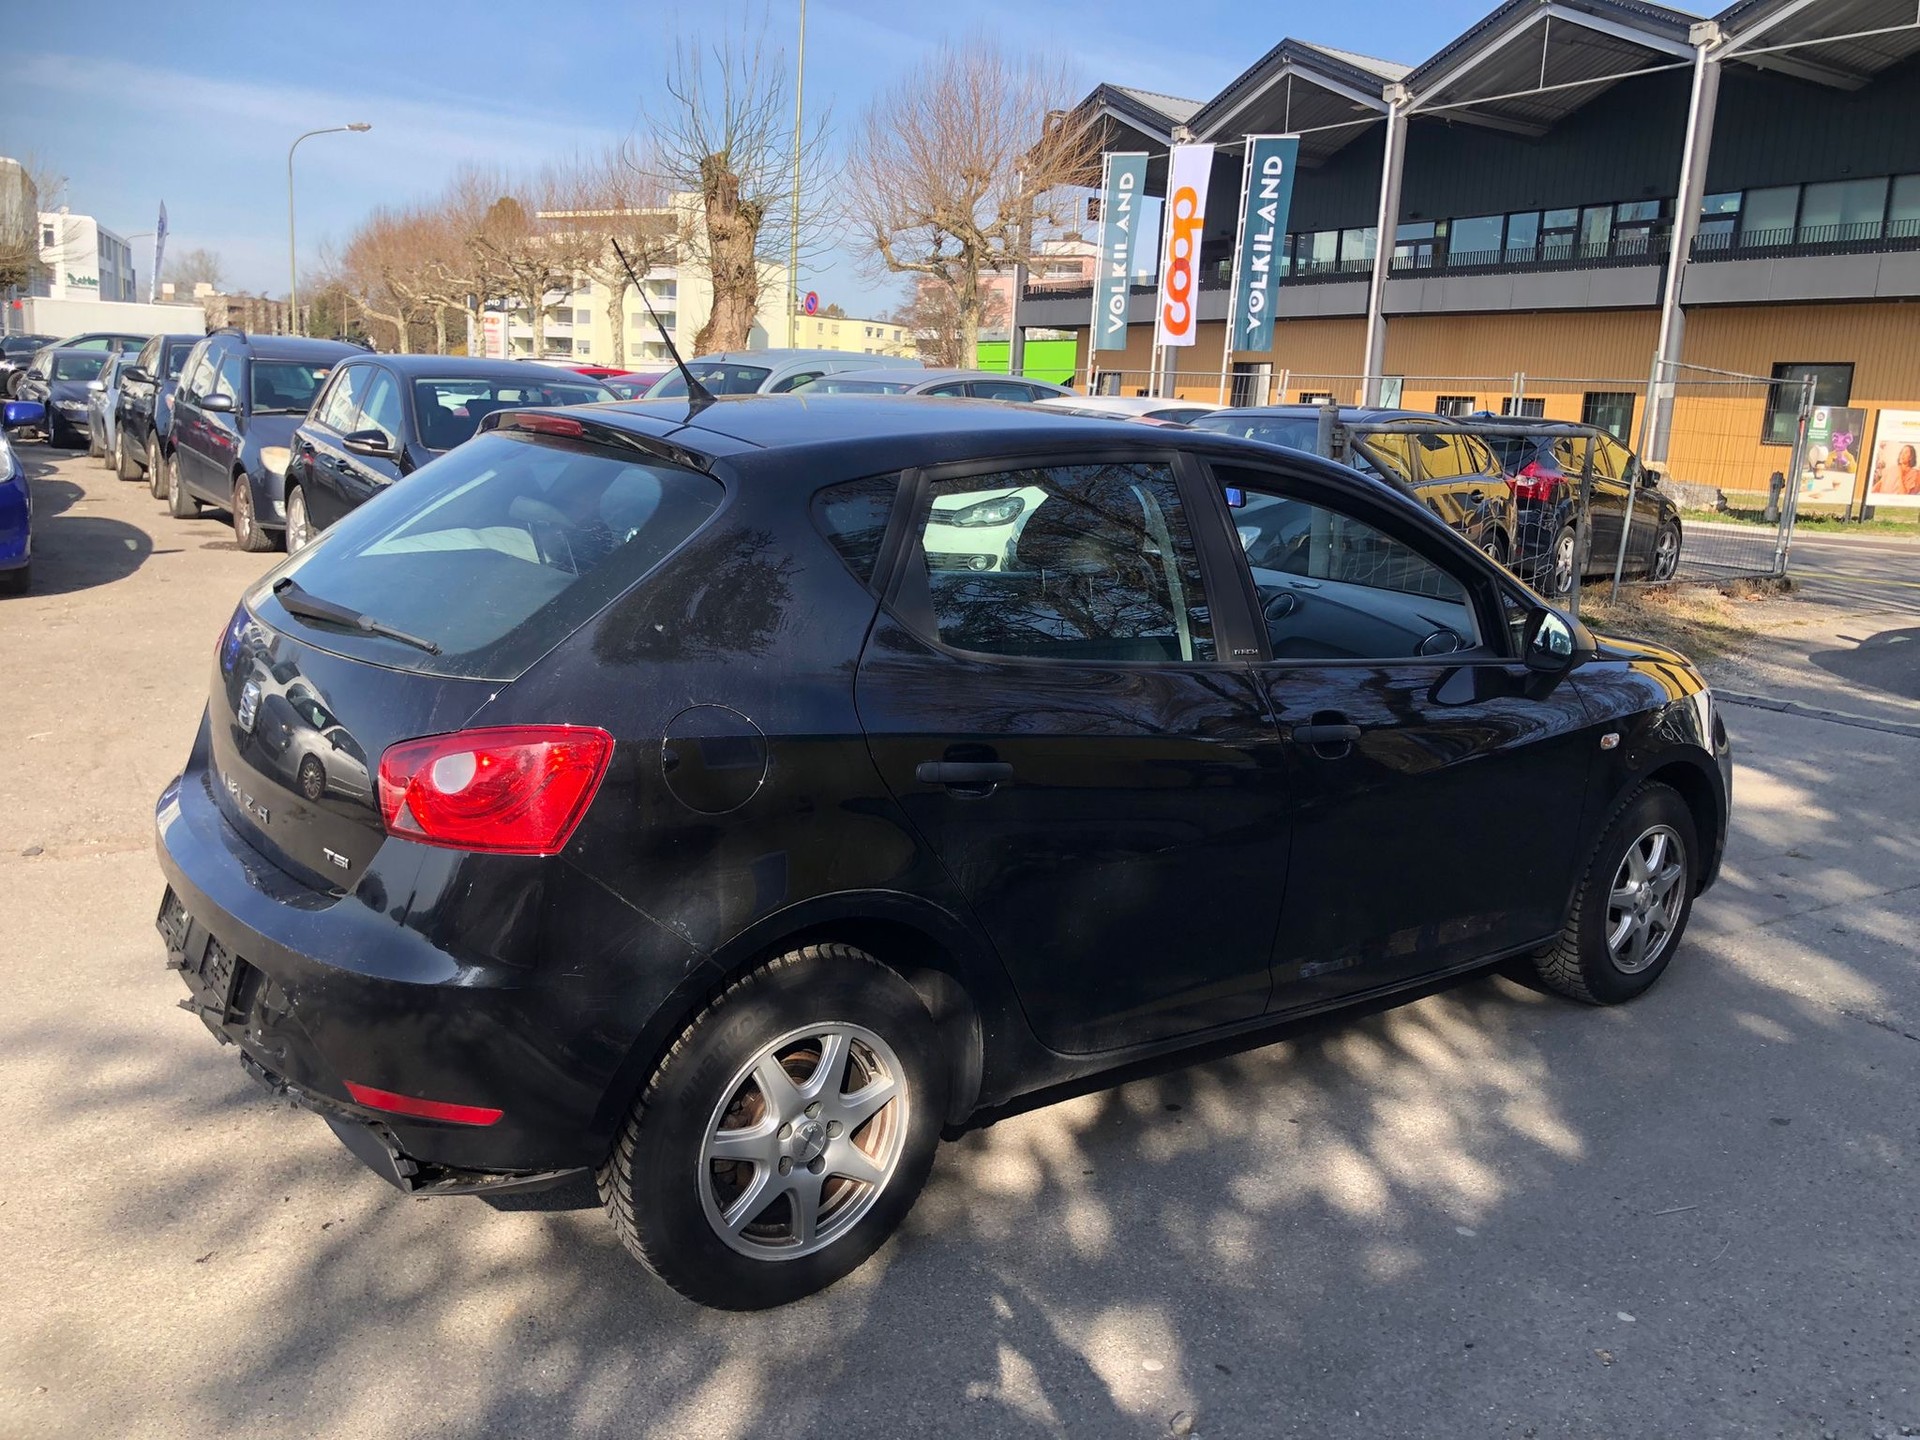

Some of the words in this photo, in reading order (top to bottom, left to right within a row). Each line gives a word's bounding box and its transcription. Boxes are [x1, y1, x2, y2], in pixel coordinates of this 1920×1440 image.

[1107, 172, 1134, 334] VOLKILAND
[1163, 186, 1205, 336] coop
[1246, 155, 1283, 335] VOLKILAND
[323, 847, 351, 870] TSI
